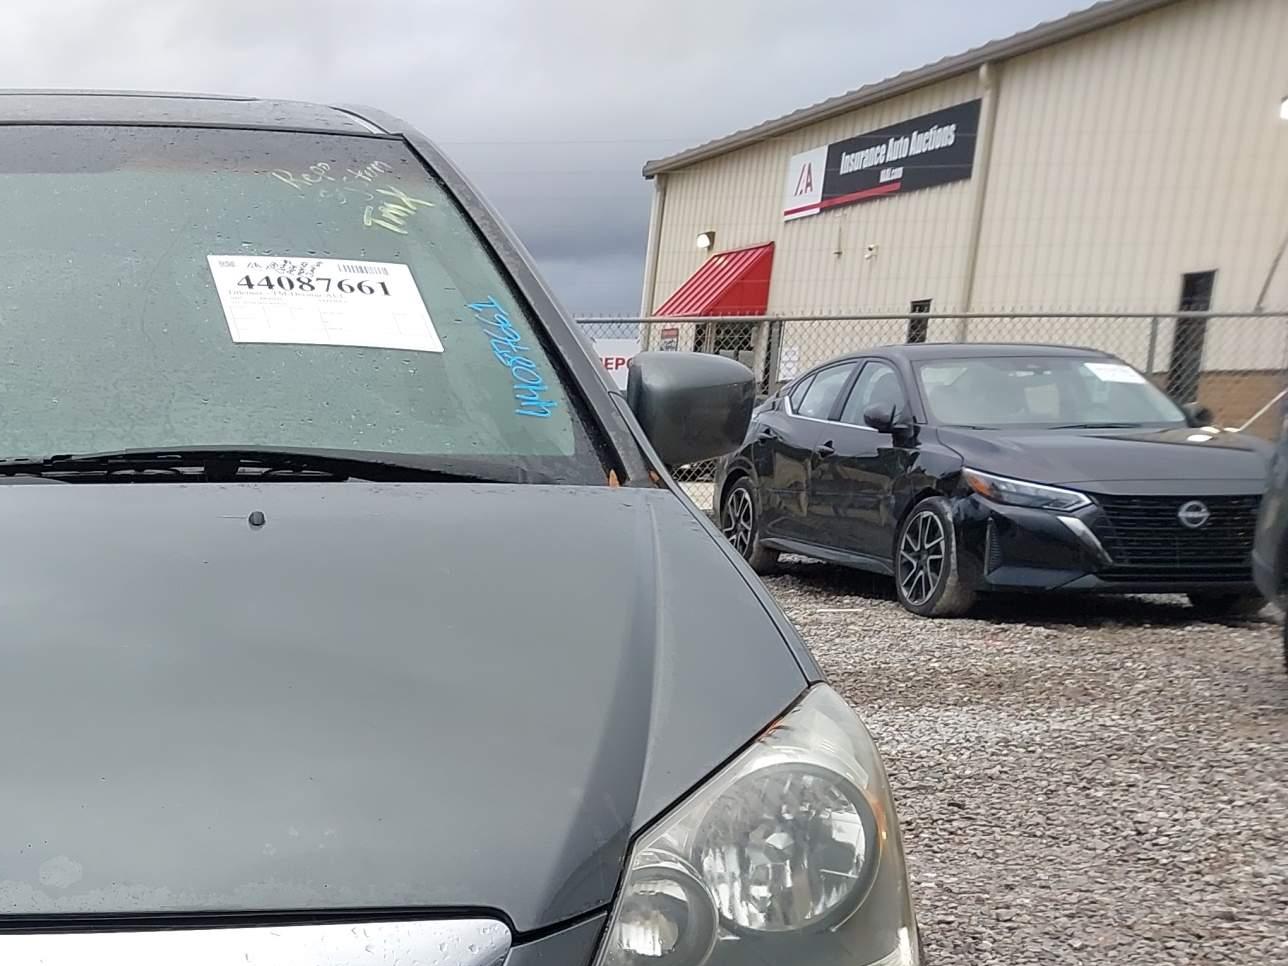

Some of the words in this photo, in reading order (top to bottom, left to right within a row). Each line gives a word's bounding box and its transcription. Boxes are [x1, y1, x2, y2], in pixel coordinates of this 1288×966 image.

[839, 143, 886, 175] Insurance
[885, 135, 910, 164] Auto
[908, 123, 956, 156] Auctions
[236, 274, 392, 297] 44087661
